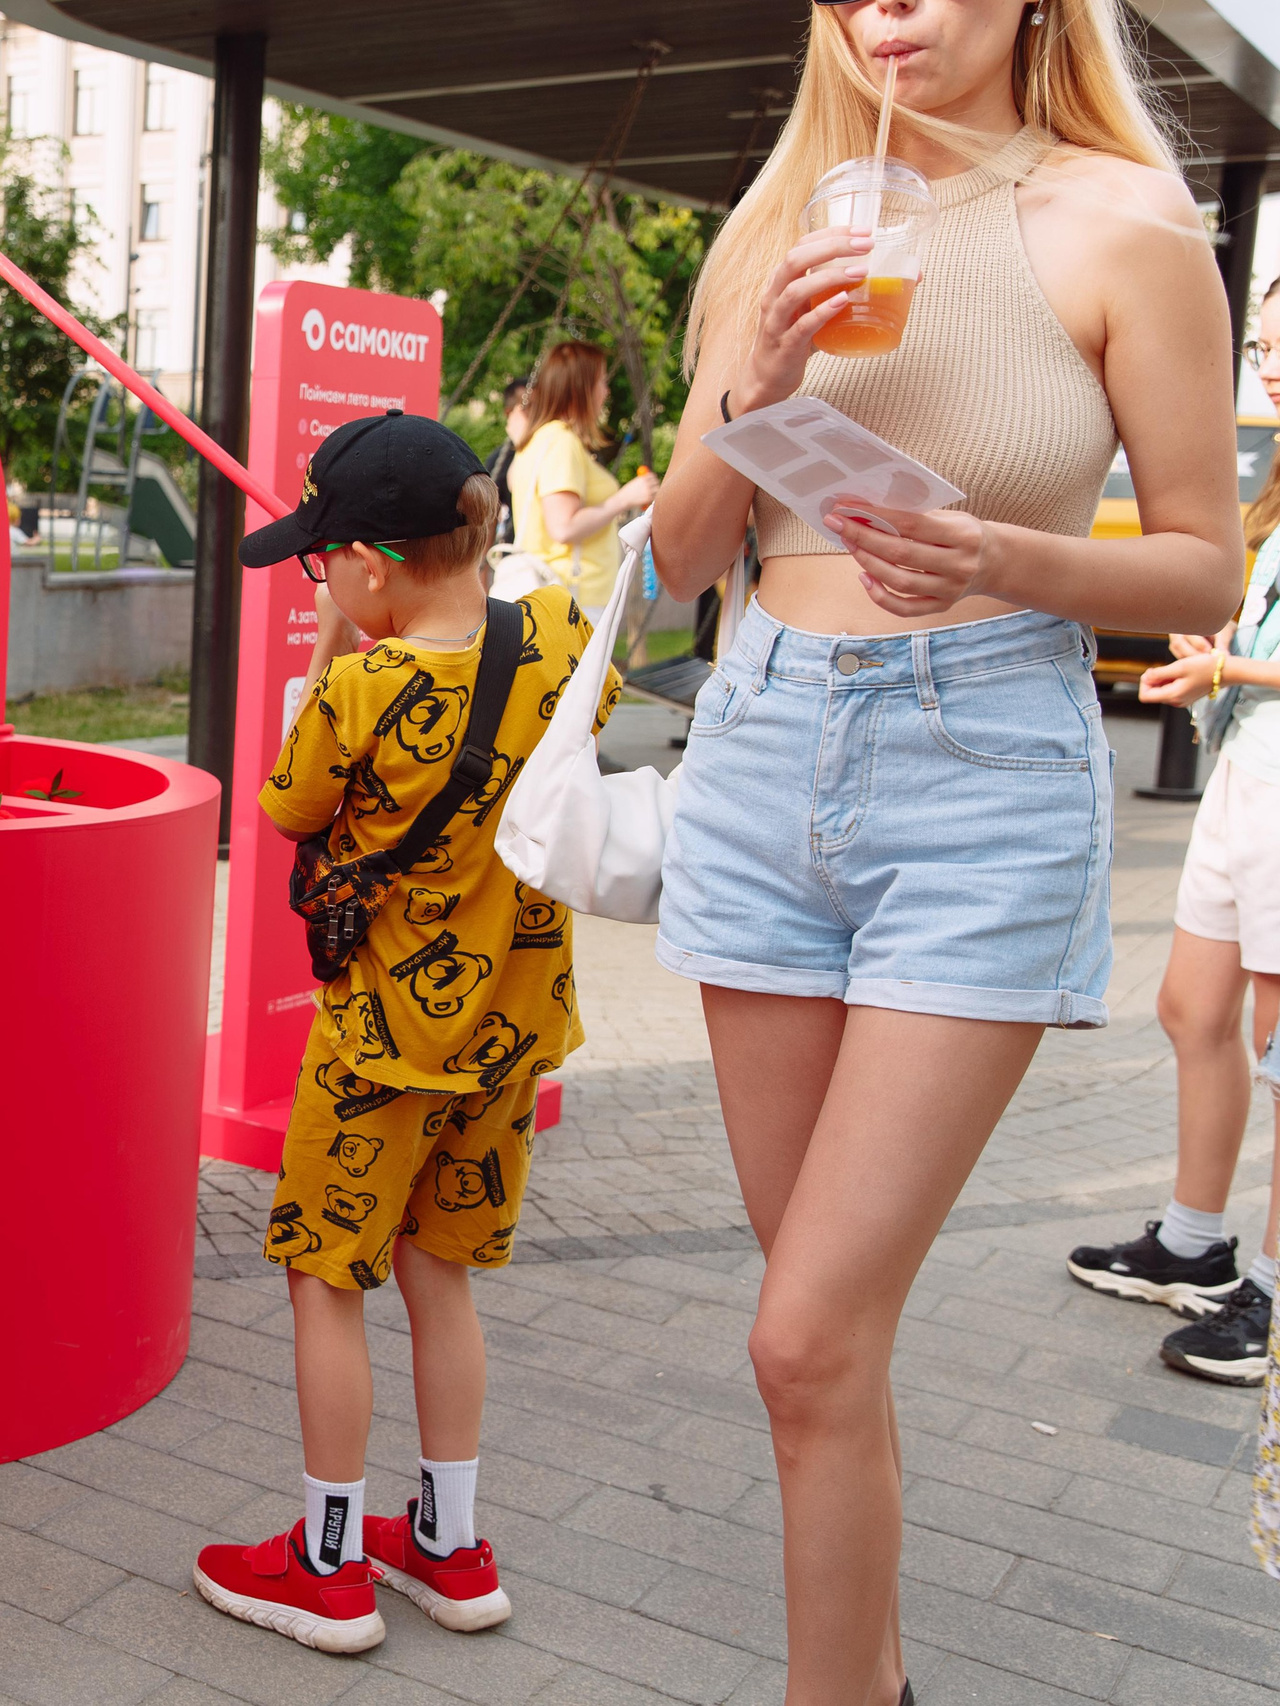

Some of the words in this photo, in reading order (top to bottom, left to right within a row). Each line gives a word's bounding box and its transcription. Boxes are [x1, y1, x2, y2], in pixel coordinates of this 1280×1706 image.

[329, 320, 430, 363] самокат
[347, 391, 371, 408] лето
[340, 1088, 399, 1119] MRSANDMA
[324, 1506, 344, 1551] КРУТОЙ
